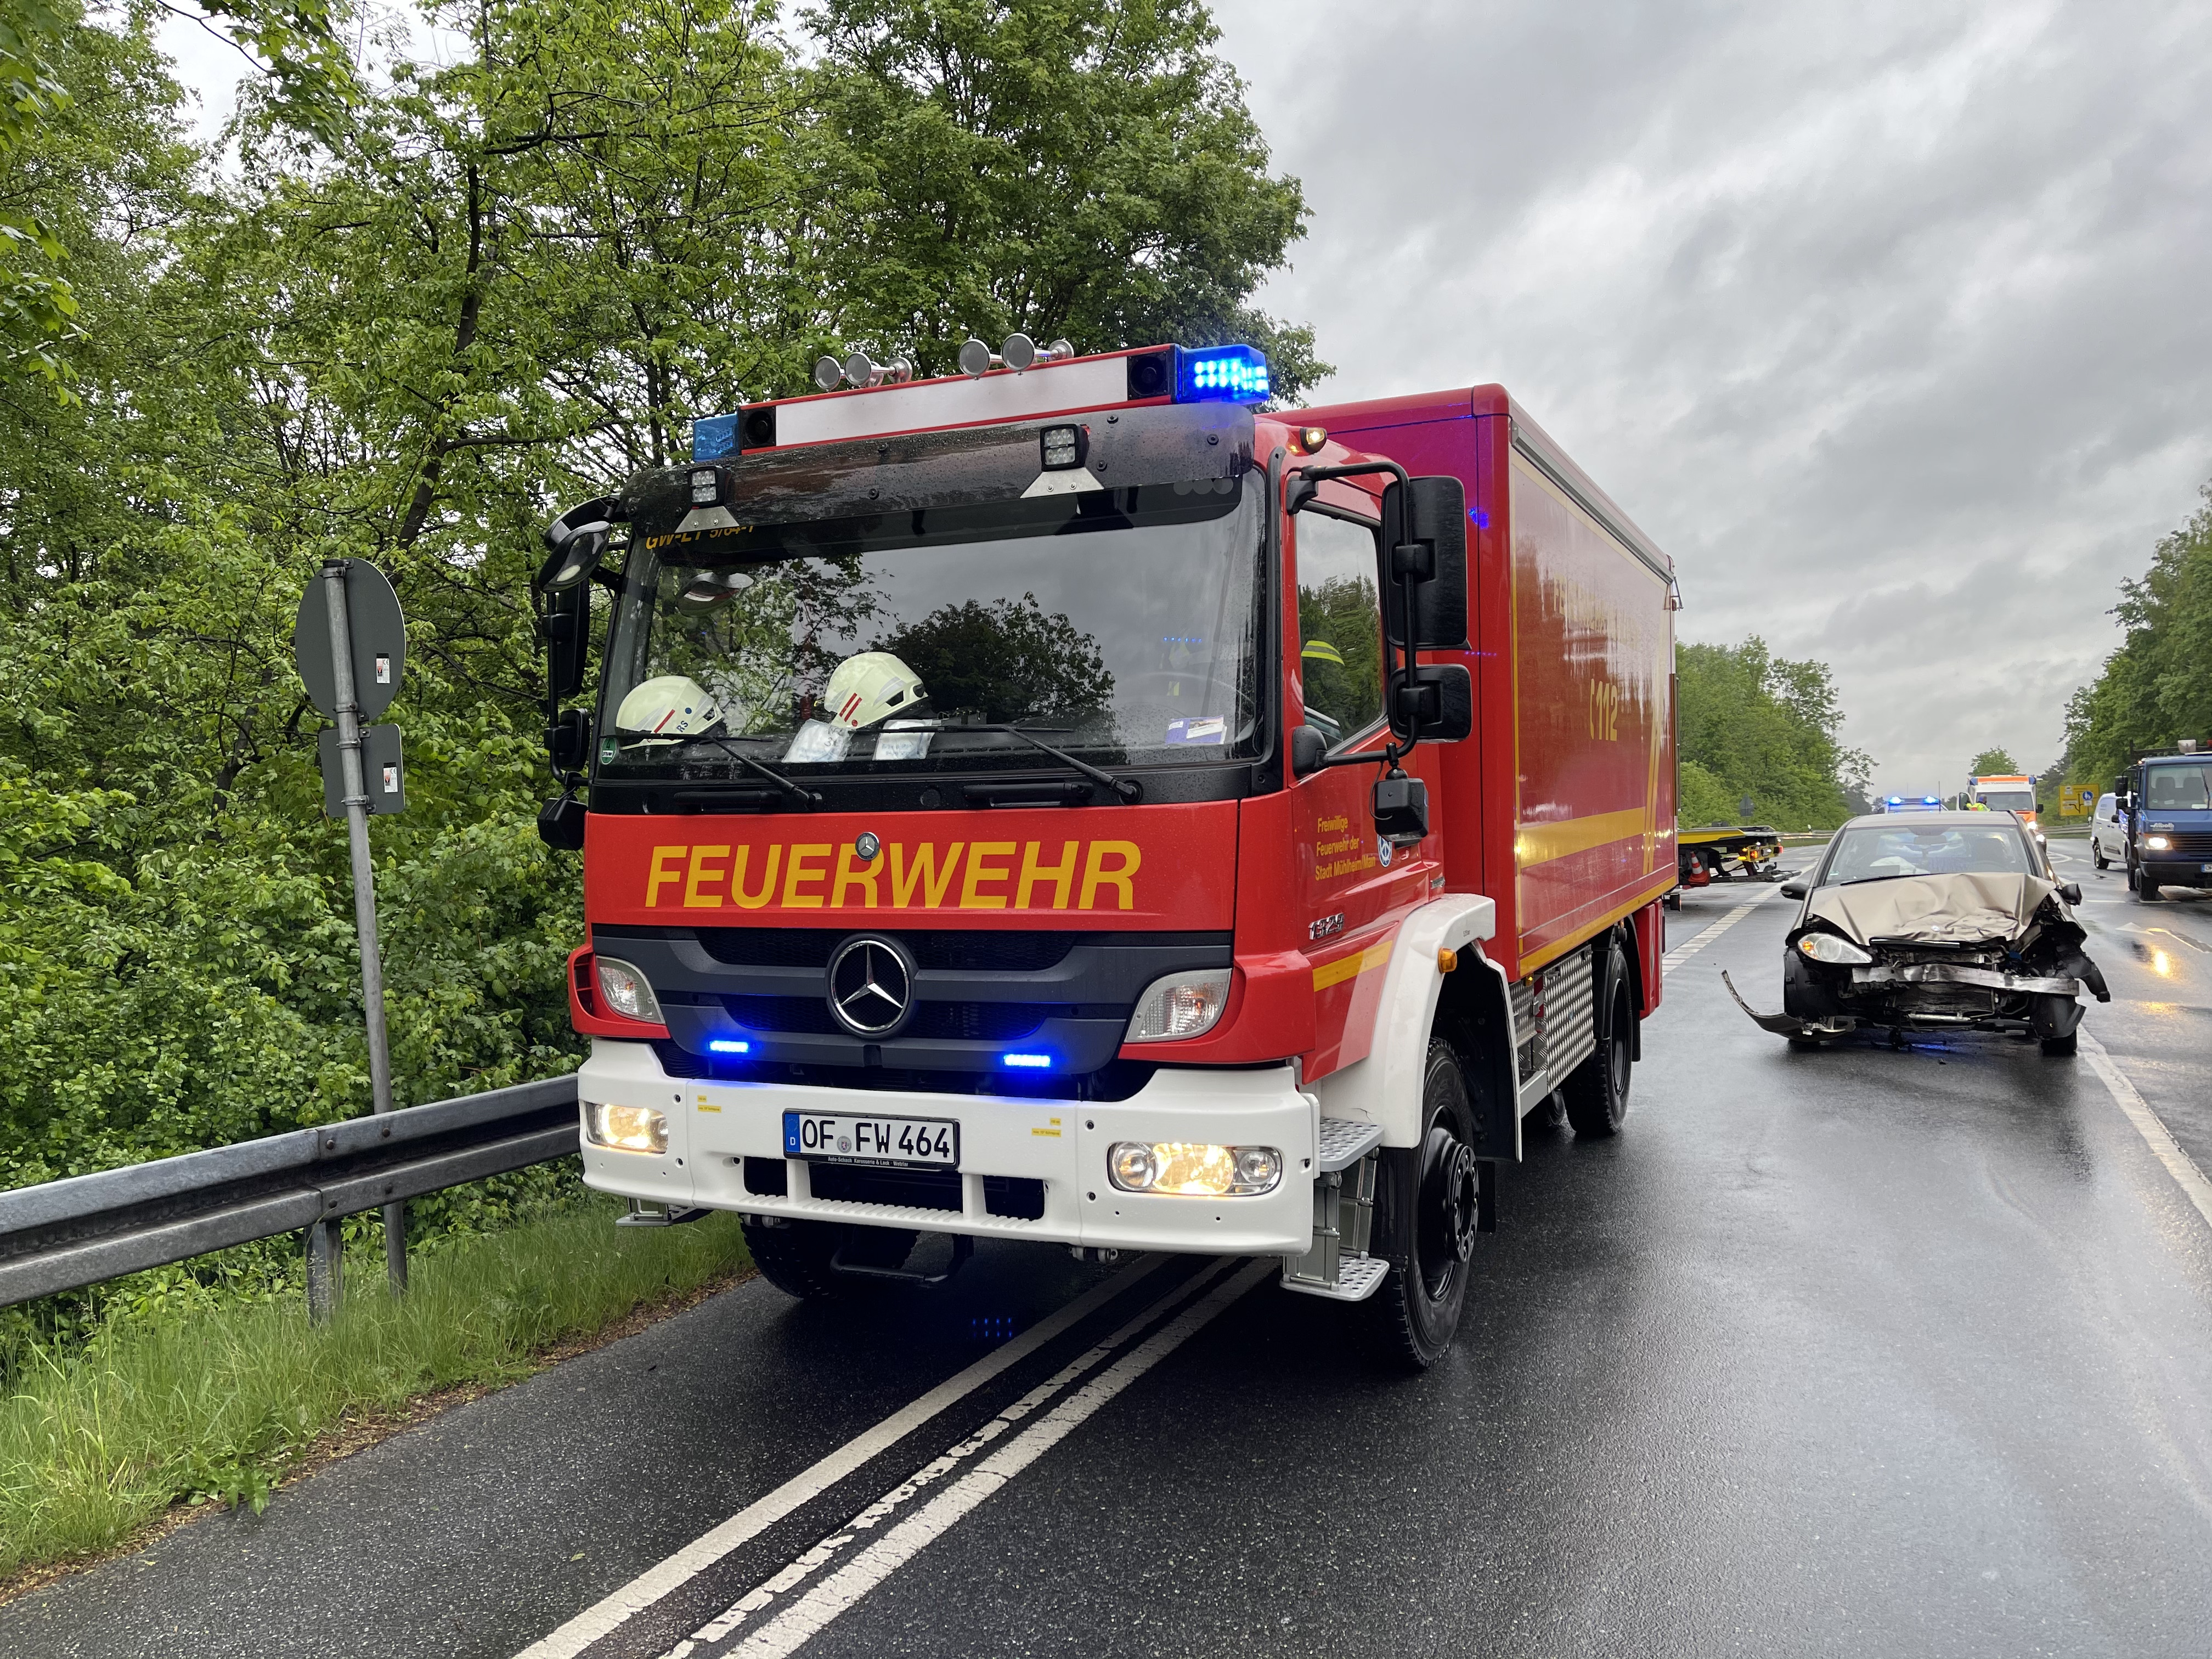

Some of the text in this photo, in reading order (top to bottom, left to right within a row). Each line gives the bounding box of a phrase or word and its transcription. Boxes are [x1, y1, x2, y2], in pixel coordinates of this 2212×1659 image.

[1596, 681, 1618, 741] 112
[676, 720, 689, 733] RS
[1317, 815, 1348, 833] Freiwillige
[1317, 835, 1359, 857] Feuerwehr der
[645, 840, 1142, 910] FEUERWEHR
[1316, 863, 1333, 881] Stadt
[790, 1137, 795, 1146] D
[802, 1119, 950, 1158] OF FW 464
